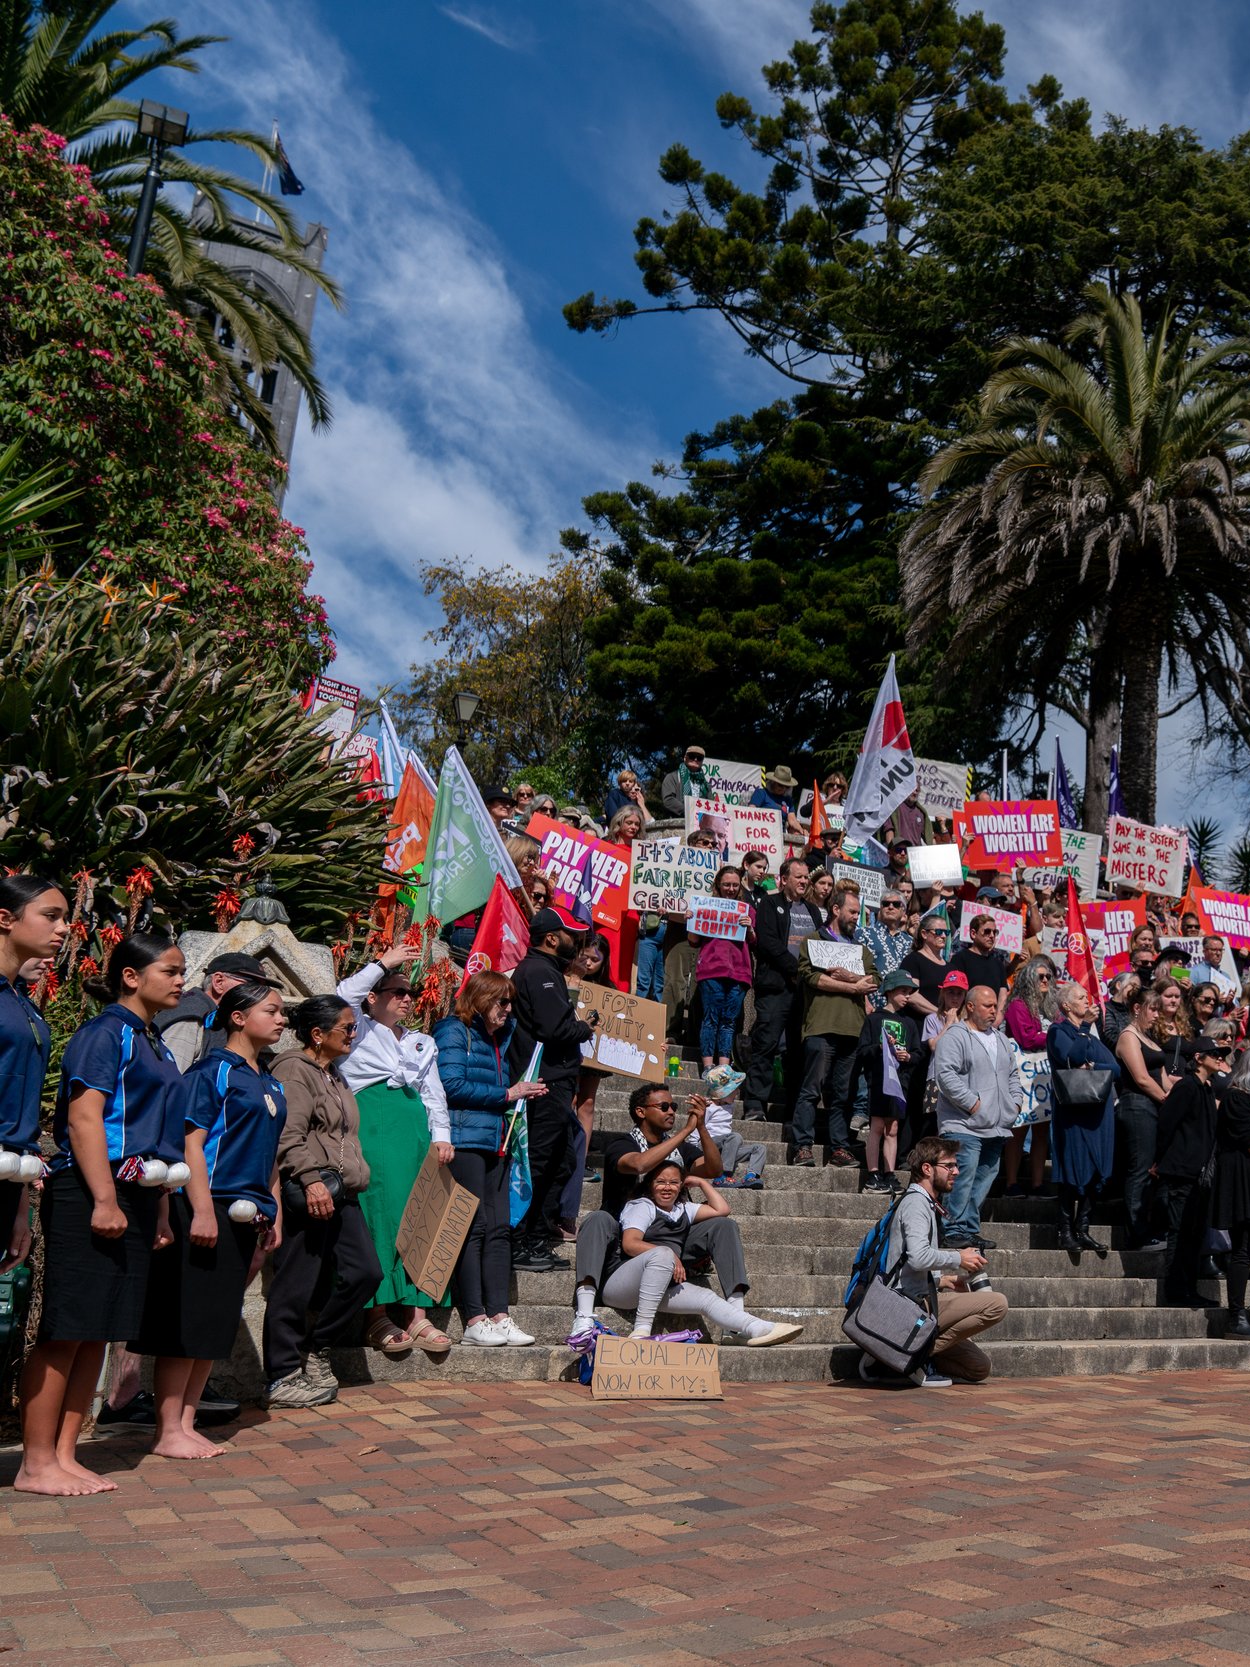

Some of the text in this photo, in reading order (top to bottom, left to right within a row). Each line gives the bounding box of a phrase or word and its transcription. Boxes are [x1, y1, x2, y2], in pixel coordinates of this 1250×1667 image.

[321, 679, 358, 695] FIGHT BACK
[347, 694, 358, 702] AKE
[918, 763, 938, 775] NO
[924, 792, 962, 810] FUTURE
[734, 810, 776, 823] THANKS
[973, 814, 1028, 834] WOMEN
[1030, 814, 1056, 832] ARE
[746, 827, 770, 840] FOR
[984, 833, 1048, 853] WORTH IT
[1066, 834, 1086, 850] THE
[1116, 822, 1180, 850] PAY THE SISTERS
[735, 842, 777, 854] NOTHING
[1112, 840, 1172, 864] SAME AS THE
[542, 830, 628, 887] PAY HER
[678, 848, 720, 871] ABOUT
[633, 863, 715, 893] FAIRNESS
[1111, 859, 1168, 887] MISTERS
[664, 888, 686, 899] NOT
[696, 908, 740, 924] FOR PAY
[994, 911, 1018, 926] CAPS
[1201, 898, 1246, 920] WOMEN
[694, 920, 739, 937] EQUITY
[1104, 910, 1136, 933] HER
[602, 991, 638, 1017] FOR
[420, 1188, 474, 1300] DISCRIMINATION
[600, 1338, 715, 1366] EQUAL PAY
[596, 1373, 632, 1390] NOW
[638, 1373, 664, 1390] FOR
[671, 1374, 699, 1390] MY
